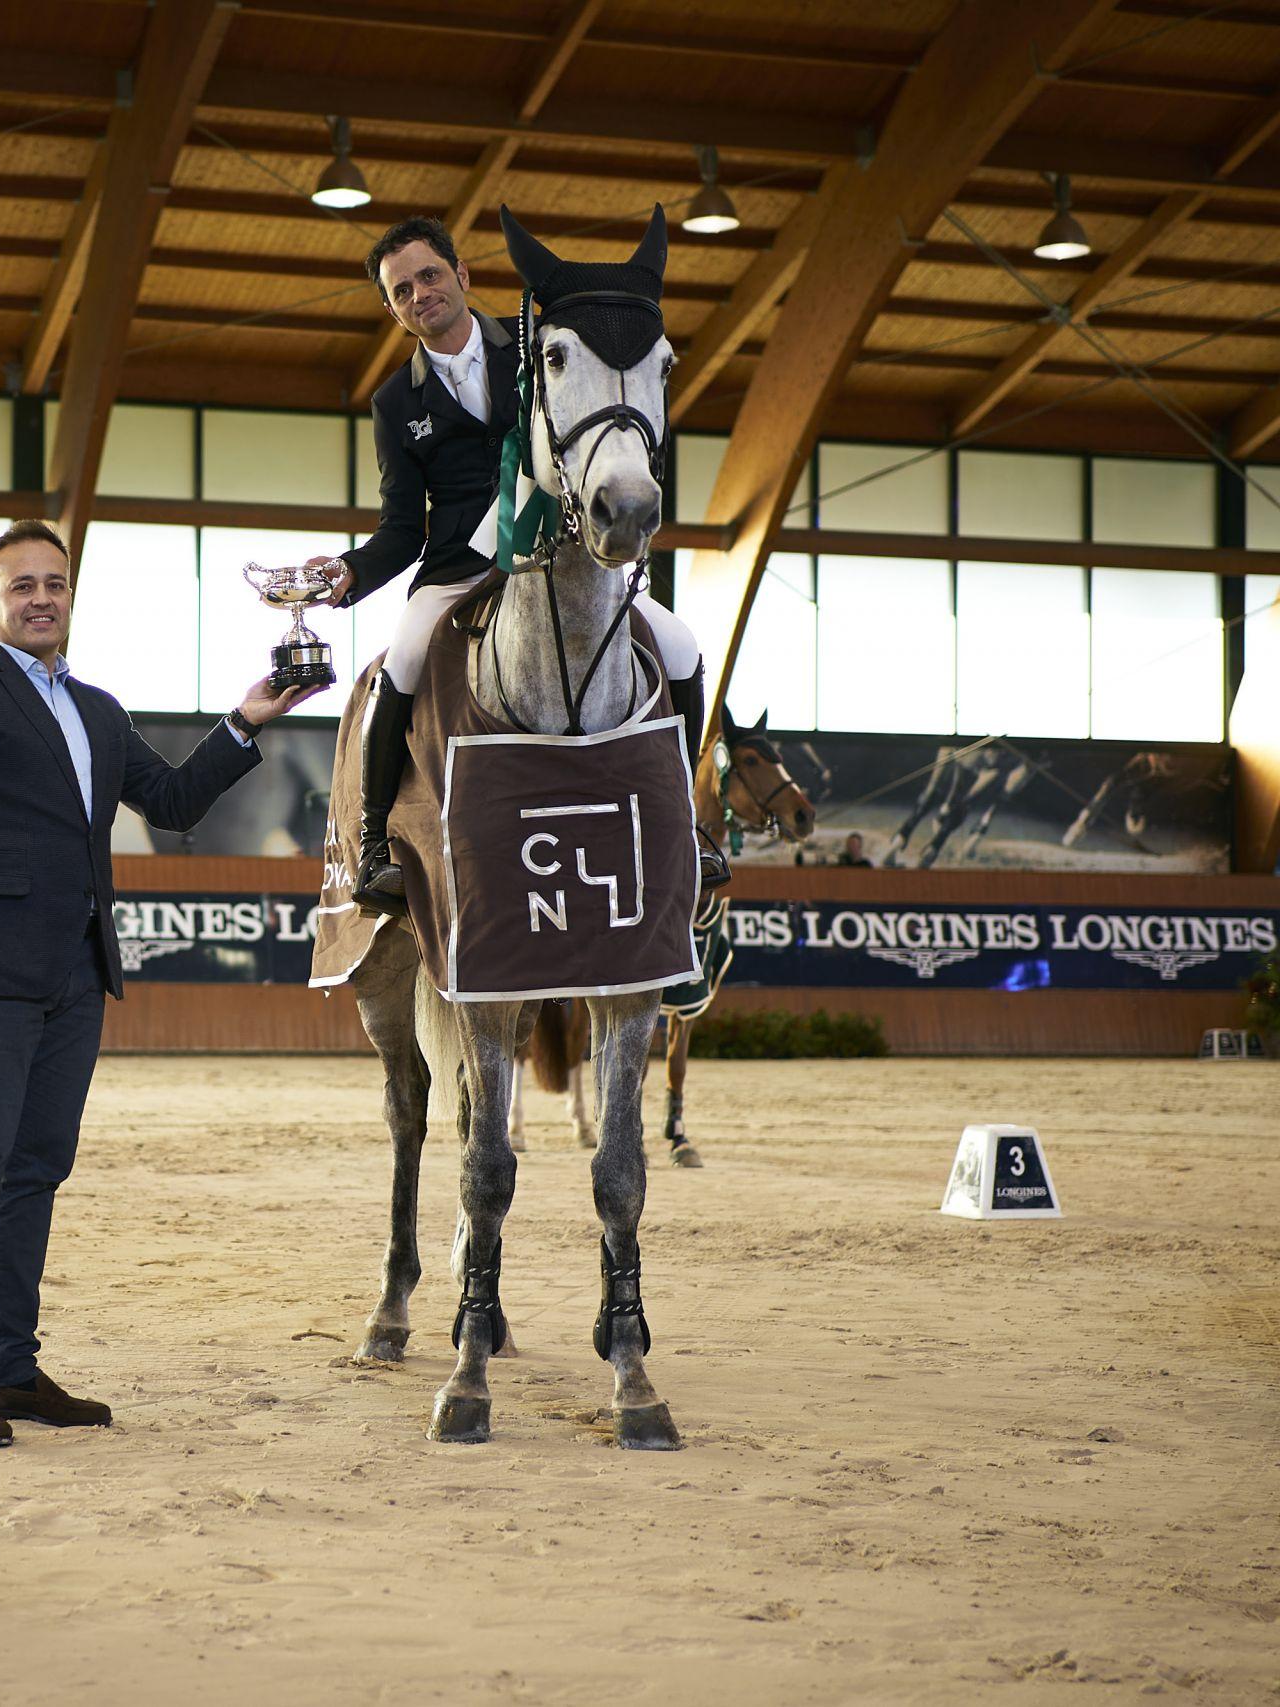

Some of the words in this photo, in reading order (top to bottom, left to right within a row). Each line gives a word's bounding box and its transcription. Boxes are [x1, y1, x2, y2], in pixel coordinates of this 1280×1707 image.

[802, 911, 1040, 950] LONGINES
[1048, 914, 1278, 952] LONGINES
[1009, 1145, 1026, 1176] 3
[996, 1186, 1047, 1198] LONGINES
